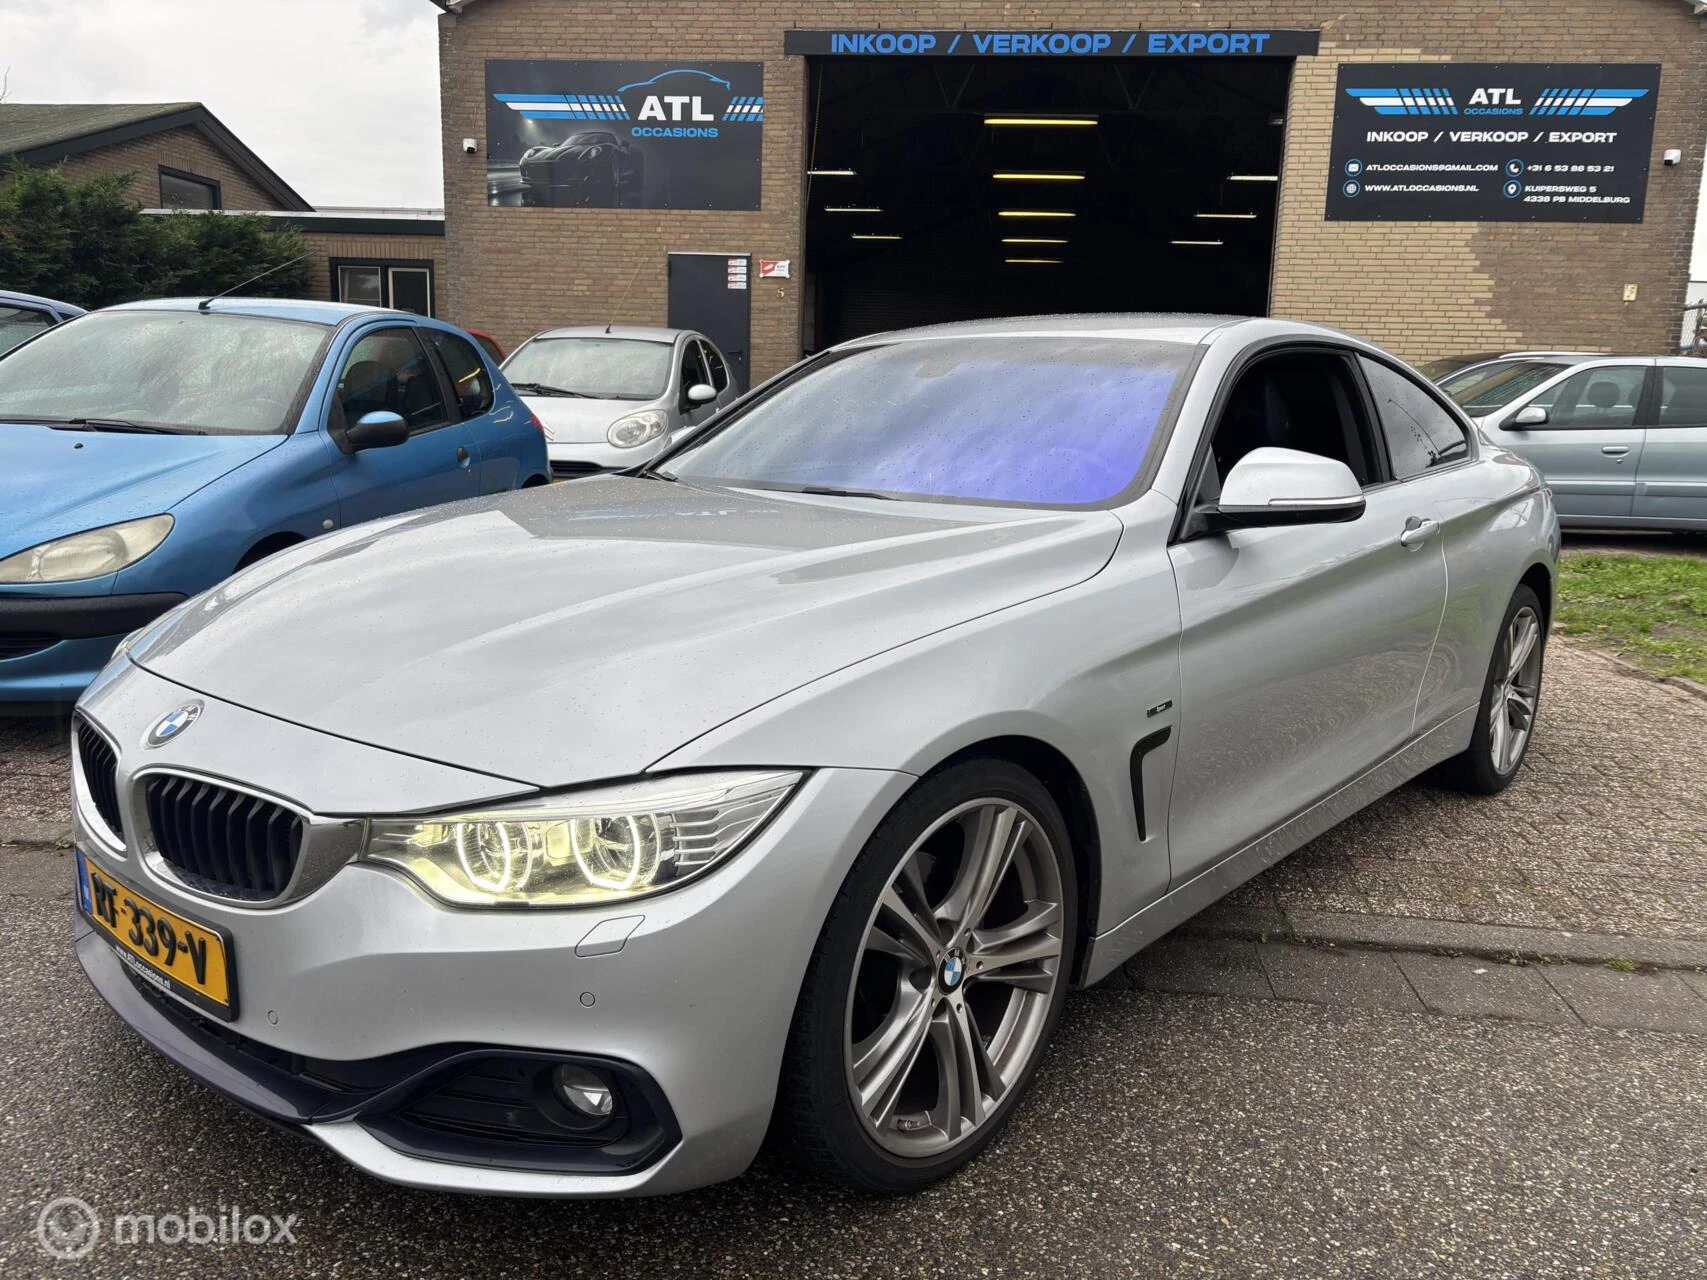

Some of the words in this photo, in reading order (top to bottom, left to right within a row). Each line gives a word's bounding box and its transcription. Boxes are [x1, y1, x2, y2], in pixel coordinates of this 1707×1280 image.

[831, 33, 938, 54] INKOOP
[947, 33, 961, 54] /
[973, 33, 1112, 54] VERKOOP
[1122, 33, 1137, 54] /
[1147, 33, 1270, 54] EXPORT
[1468, 88, 1522, 105] ATL
[637, 95, 715, 121] ATL
[1463, 107, 1524, 116] OCCASIONS
[631, 127, 719, 138] OCCASIONS
[1366, 131, 1429, 143] INKOOP
[1433, 131, 1444, 143] /
[1449, 131, 1530, 143] VERKOOP
[1532, 131, 1545, 143] /
[1549, 131, 1618, 144] EXPORT
[1524, 184, 1588, 193] KUIPERSWEG
[1567, 195, 1631, 204] MIDDELBURG
[776, 287, 785, 298] 5
